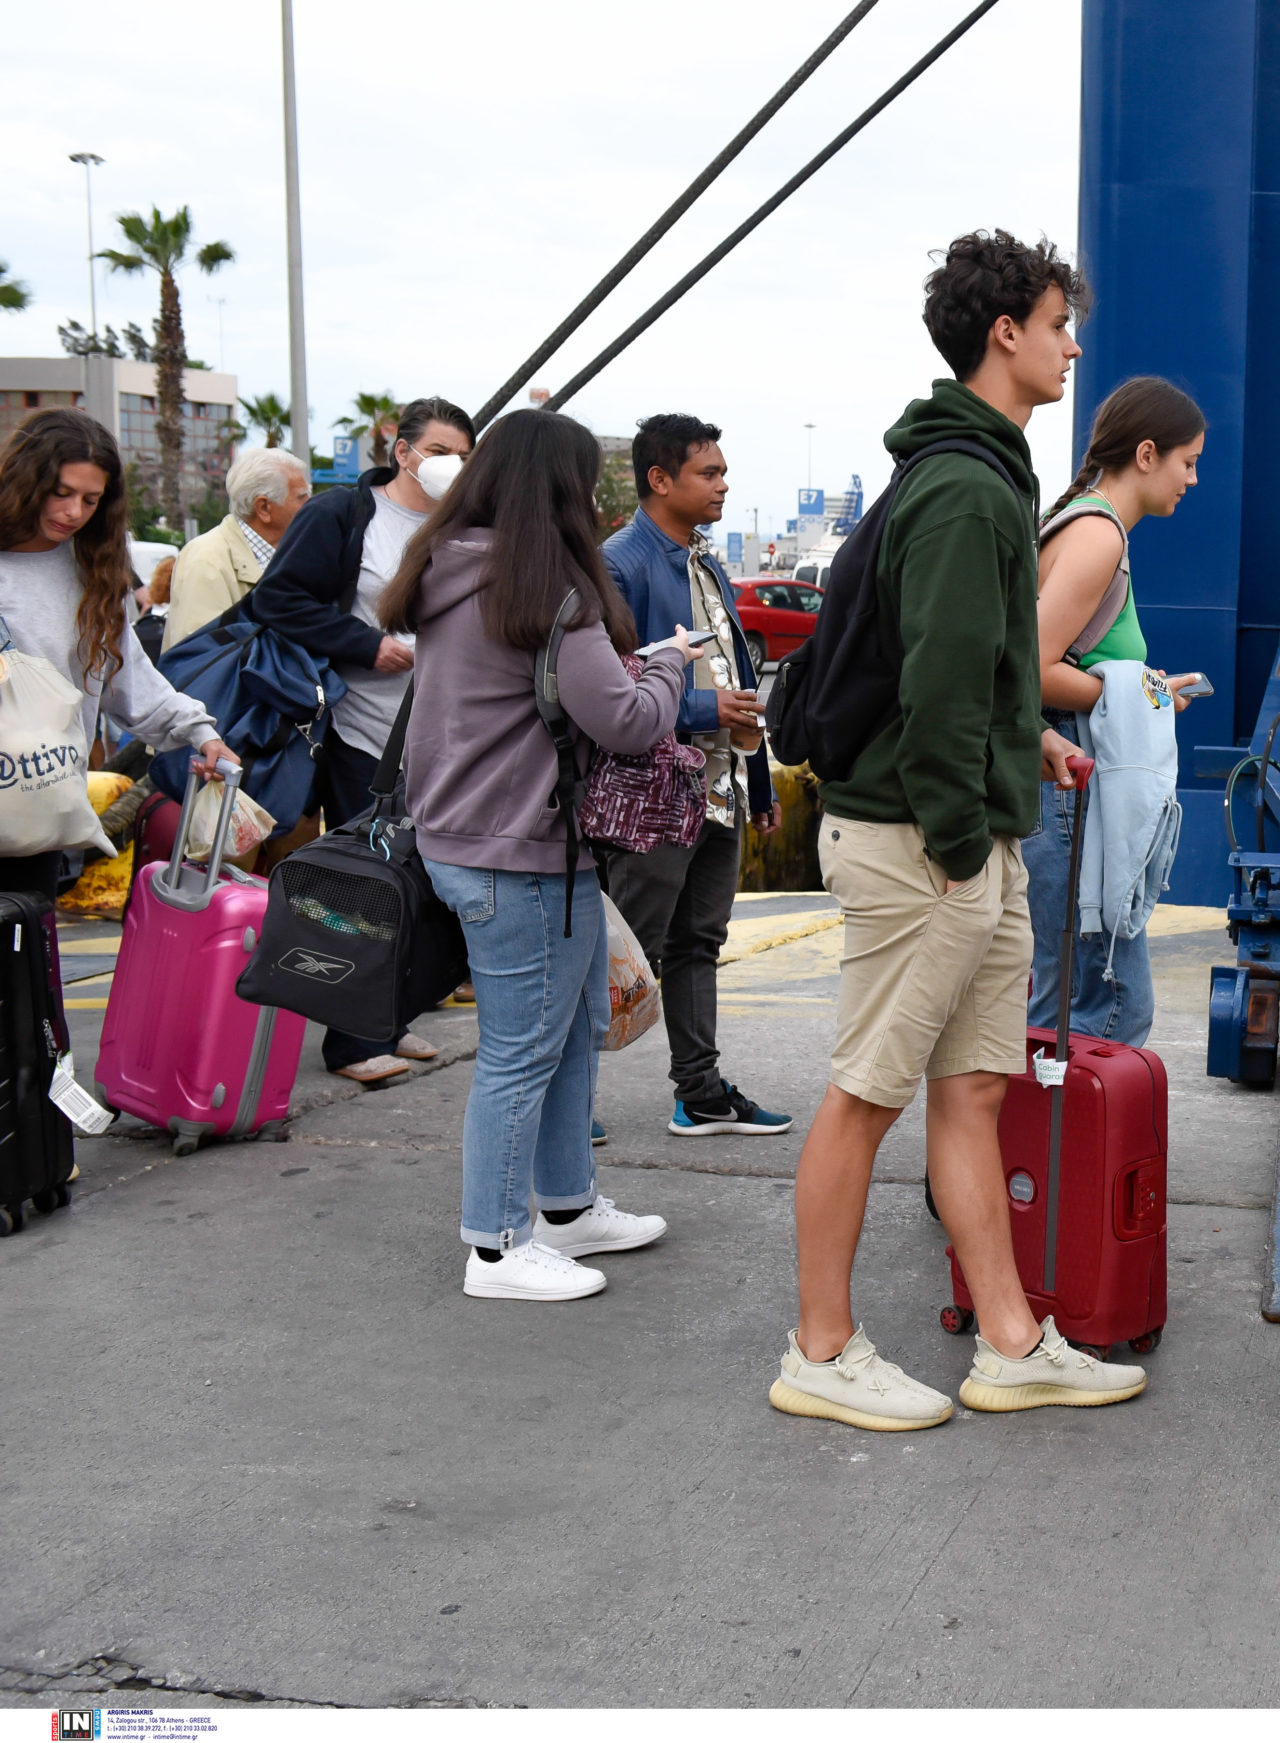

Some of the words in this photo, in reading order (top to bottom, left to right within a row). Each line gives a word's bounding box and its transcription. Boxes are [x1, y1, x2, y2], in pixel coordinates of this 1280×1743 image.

[334, 439, 353, 454] E7
[800, 490, 818, 504] E7
[1038, 1064, 1060, 1072] Cabin
